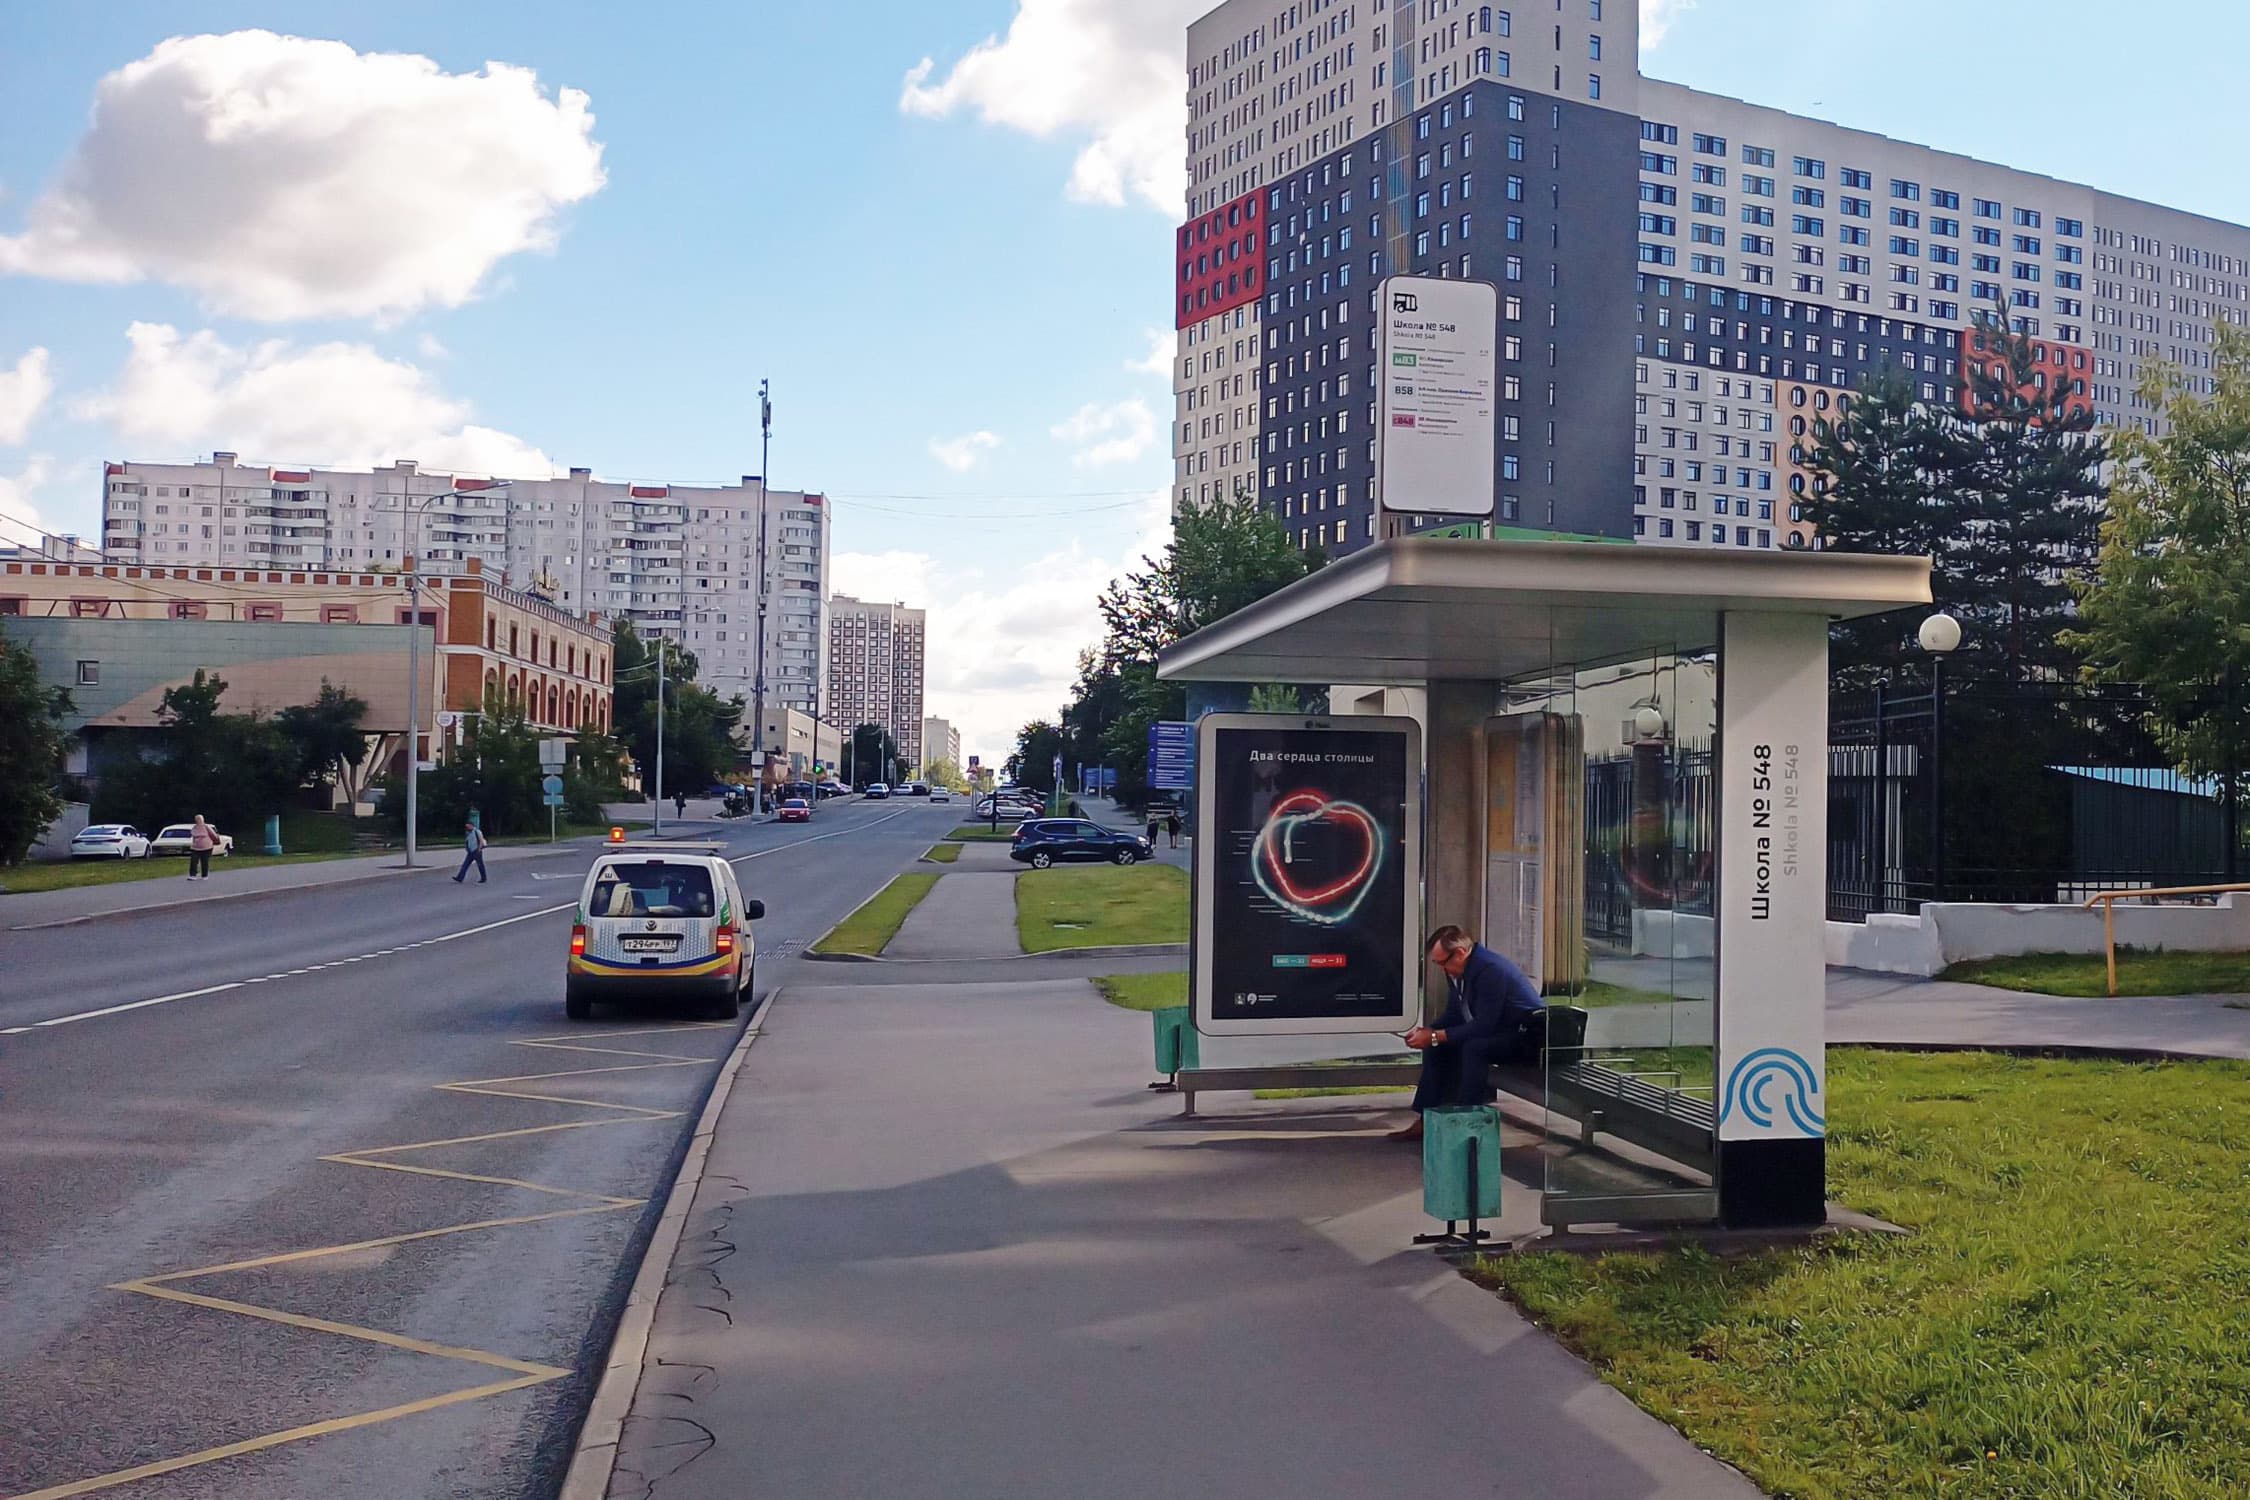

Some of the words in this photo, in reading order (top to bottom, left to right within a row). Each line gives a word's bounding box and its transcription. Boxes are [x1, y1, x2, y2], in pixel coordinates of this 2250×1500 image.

[1394, 320, 1423, 330] Школа
[1426, 323, 1437, 331] №
[1439, 324, 1455, 332] 548
[1249, 750, 1273, 762] Два
[1277, 752, 1321, 763] сердца
[1324, 754, 1374, 763] столицы
[1753, 745, 1771, 791] 548
[1785, 745, 1798, 779] 548
[1753, 798, 1770, 828] №
[1784, 786, 1798, 808] №
[1784, 815, 1798, 876] Shkola
[1752, 837, 1770, 919] Школа
